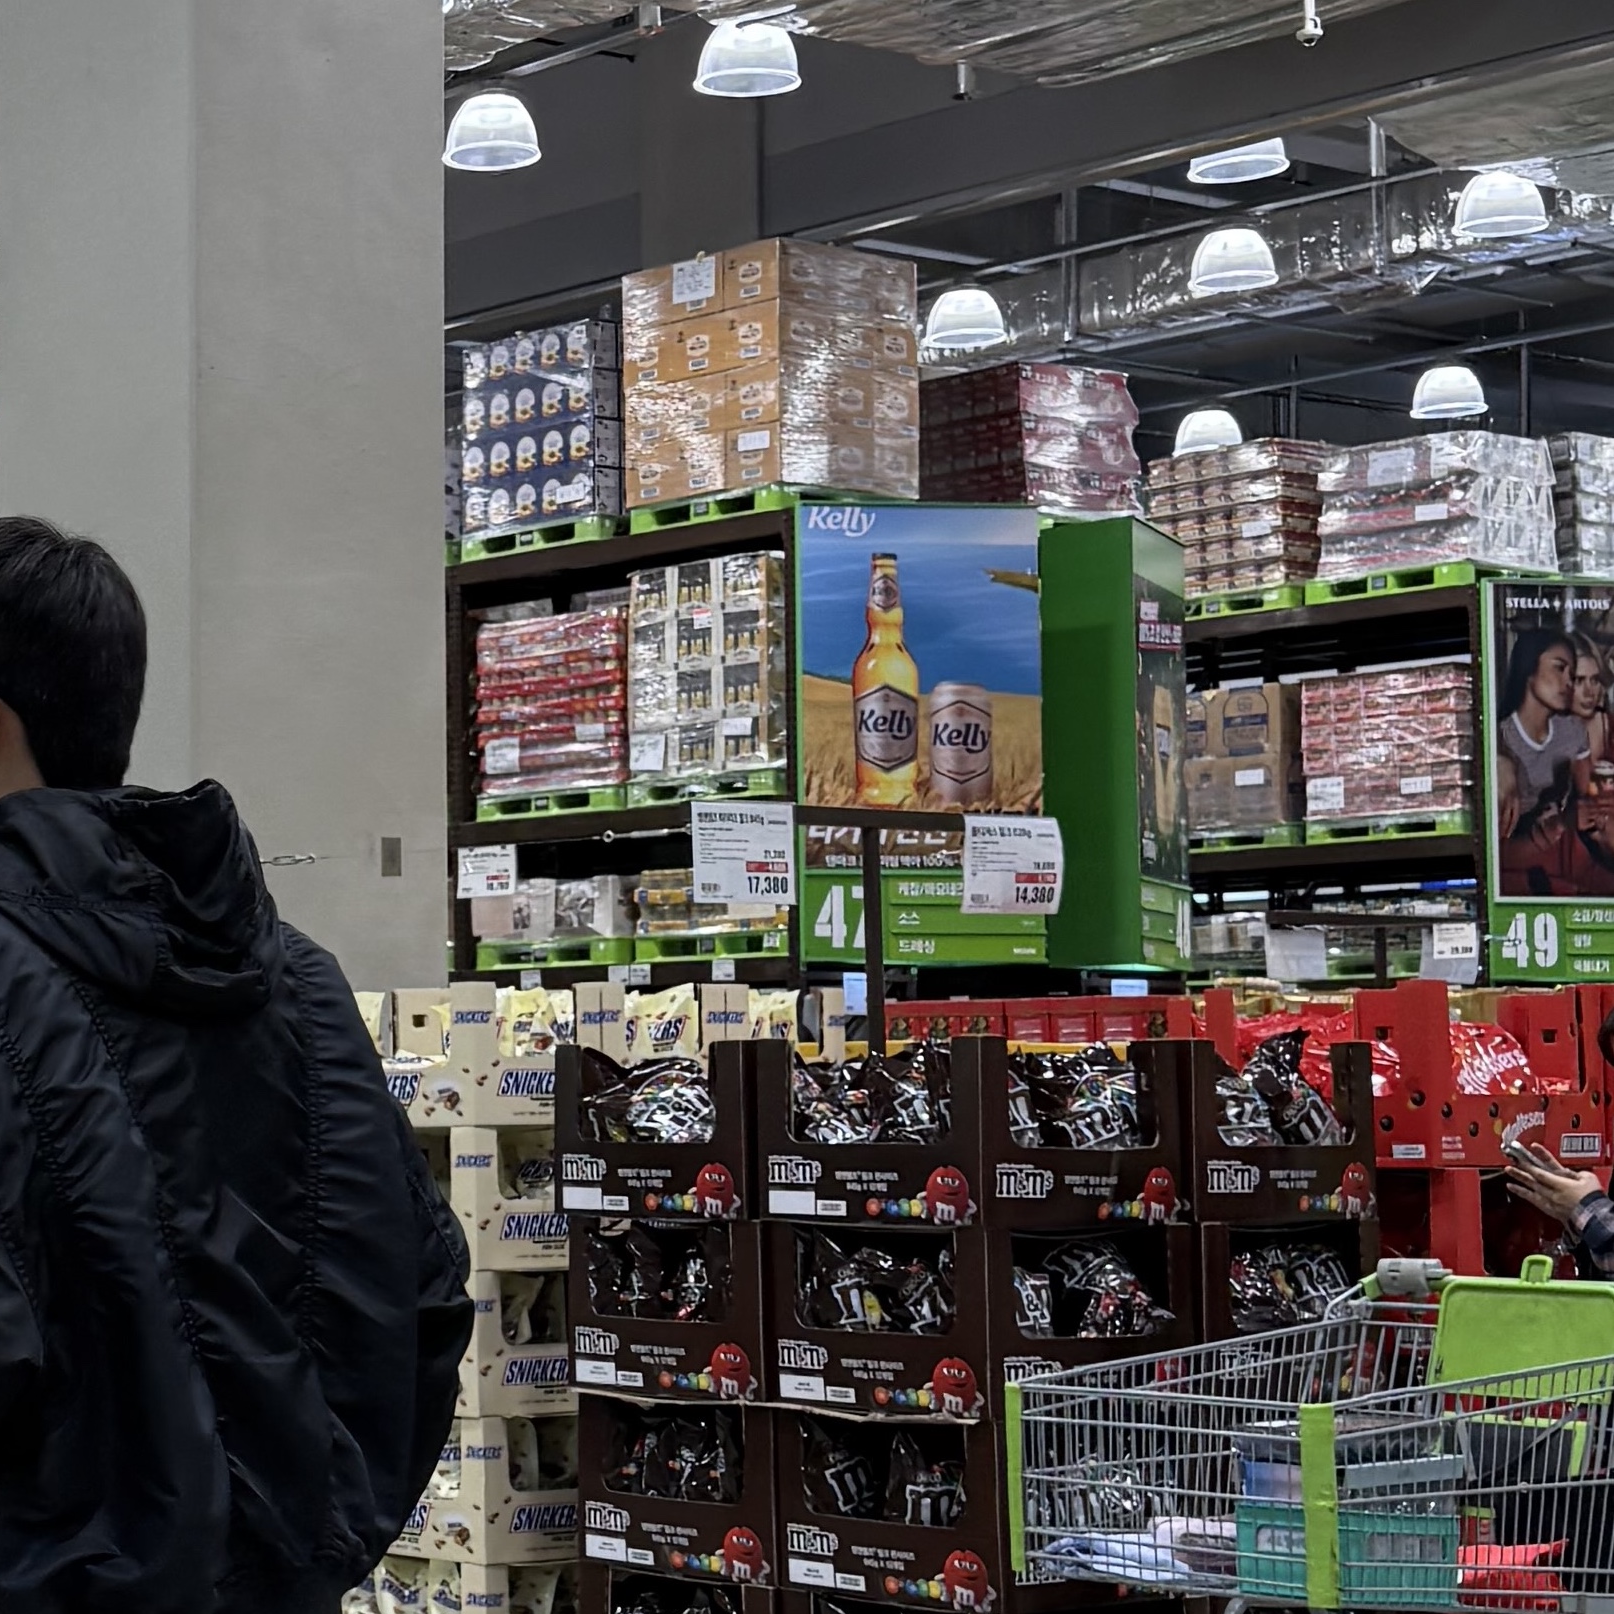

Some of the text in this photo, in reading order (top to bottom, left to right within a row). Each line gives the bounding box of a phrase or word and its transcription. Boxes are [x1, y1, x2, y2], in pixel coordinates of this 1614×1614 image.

[808, 506, 875, 537] Kelly
[1505, 597, 1611, 610] STELLA ARTOIS
[859, 709, 915, 740] Kelly
[933, 723, 991, 754] Kelly
[748, 876, 788, 895] 17,380
[1016, 886, 1055, 904] 14,380
[898, 939, 935, 954] 드레싱
[1502, 912, 1558, 968] 49
[500, 1070, 555, 1096] SNICKE
[505, 1358, 568, 1385] SNICKER
